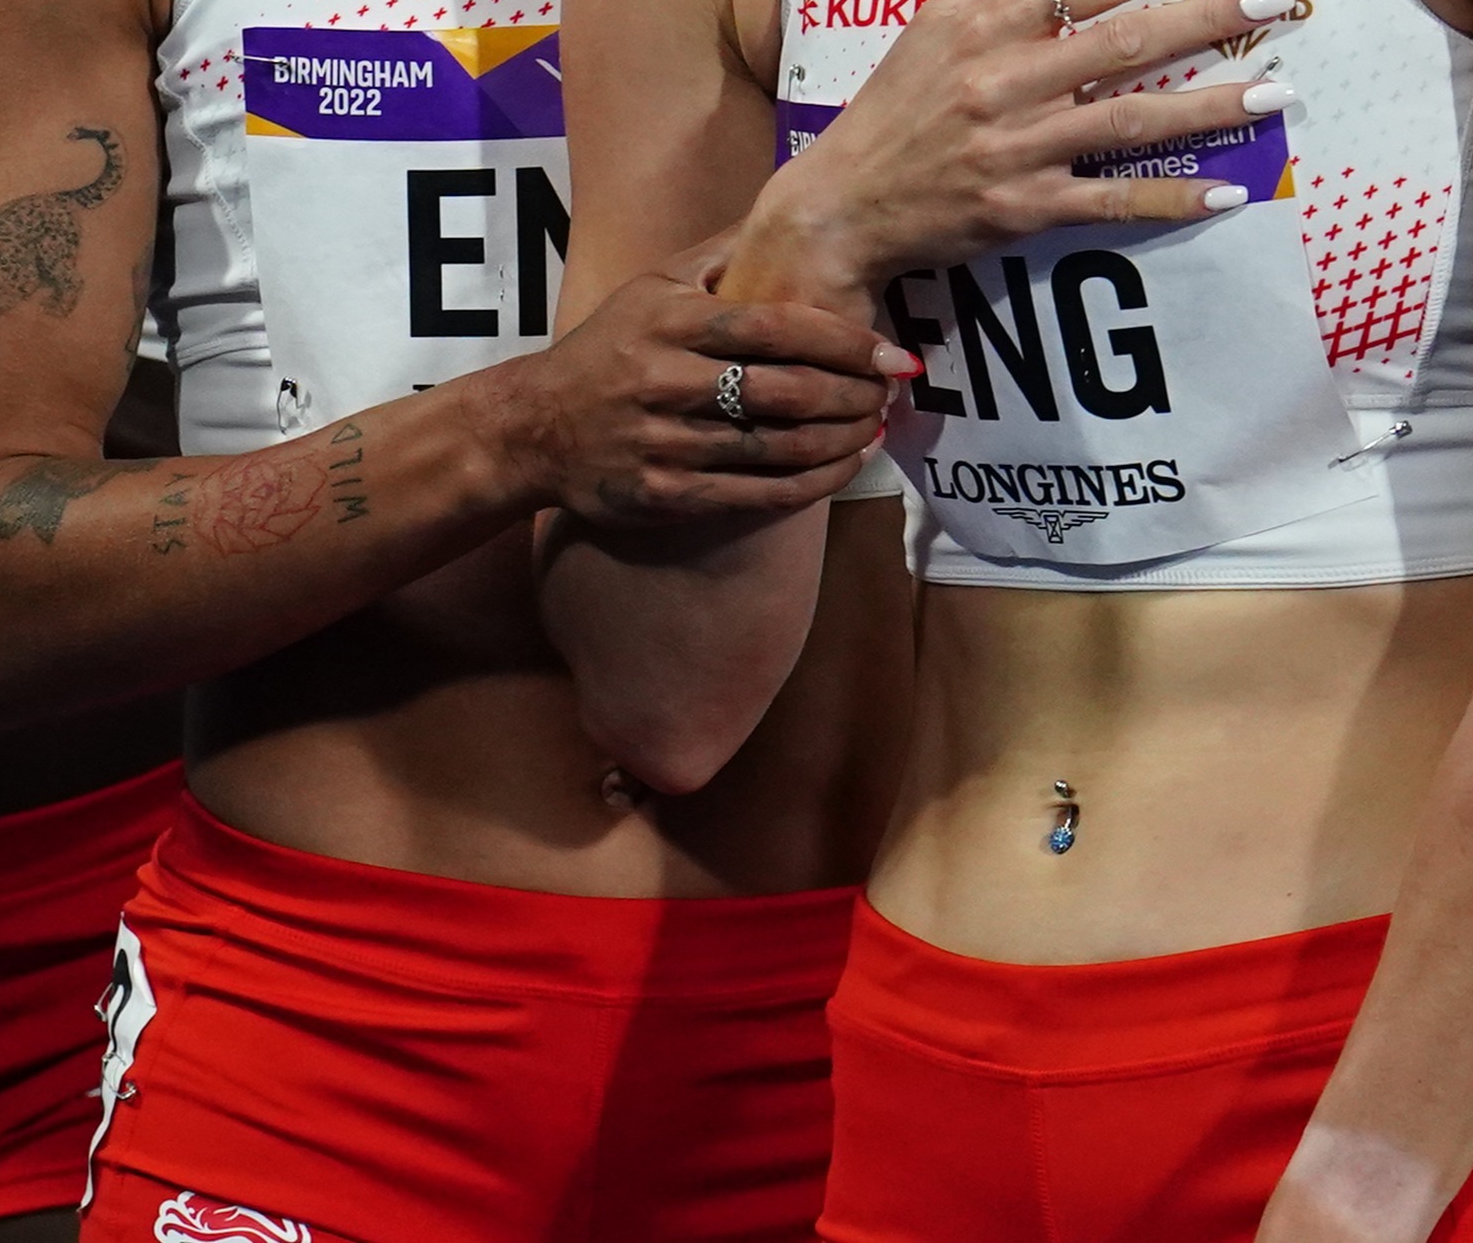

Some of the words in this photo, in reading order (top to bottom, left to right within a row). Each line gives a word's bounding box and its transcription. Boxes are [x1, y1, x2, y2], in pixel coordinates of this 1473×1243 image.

[273, 56, 434, 89] BIRMINGHAM
[318, 87, 383, 117] 2022
[884, 249, 1172, 422] ENG
[329, 423, 370, 524] WILD
[925, 458, 1186, 507] LONGINES
[152, 473, 197, 555] STAY
